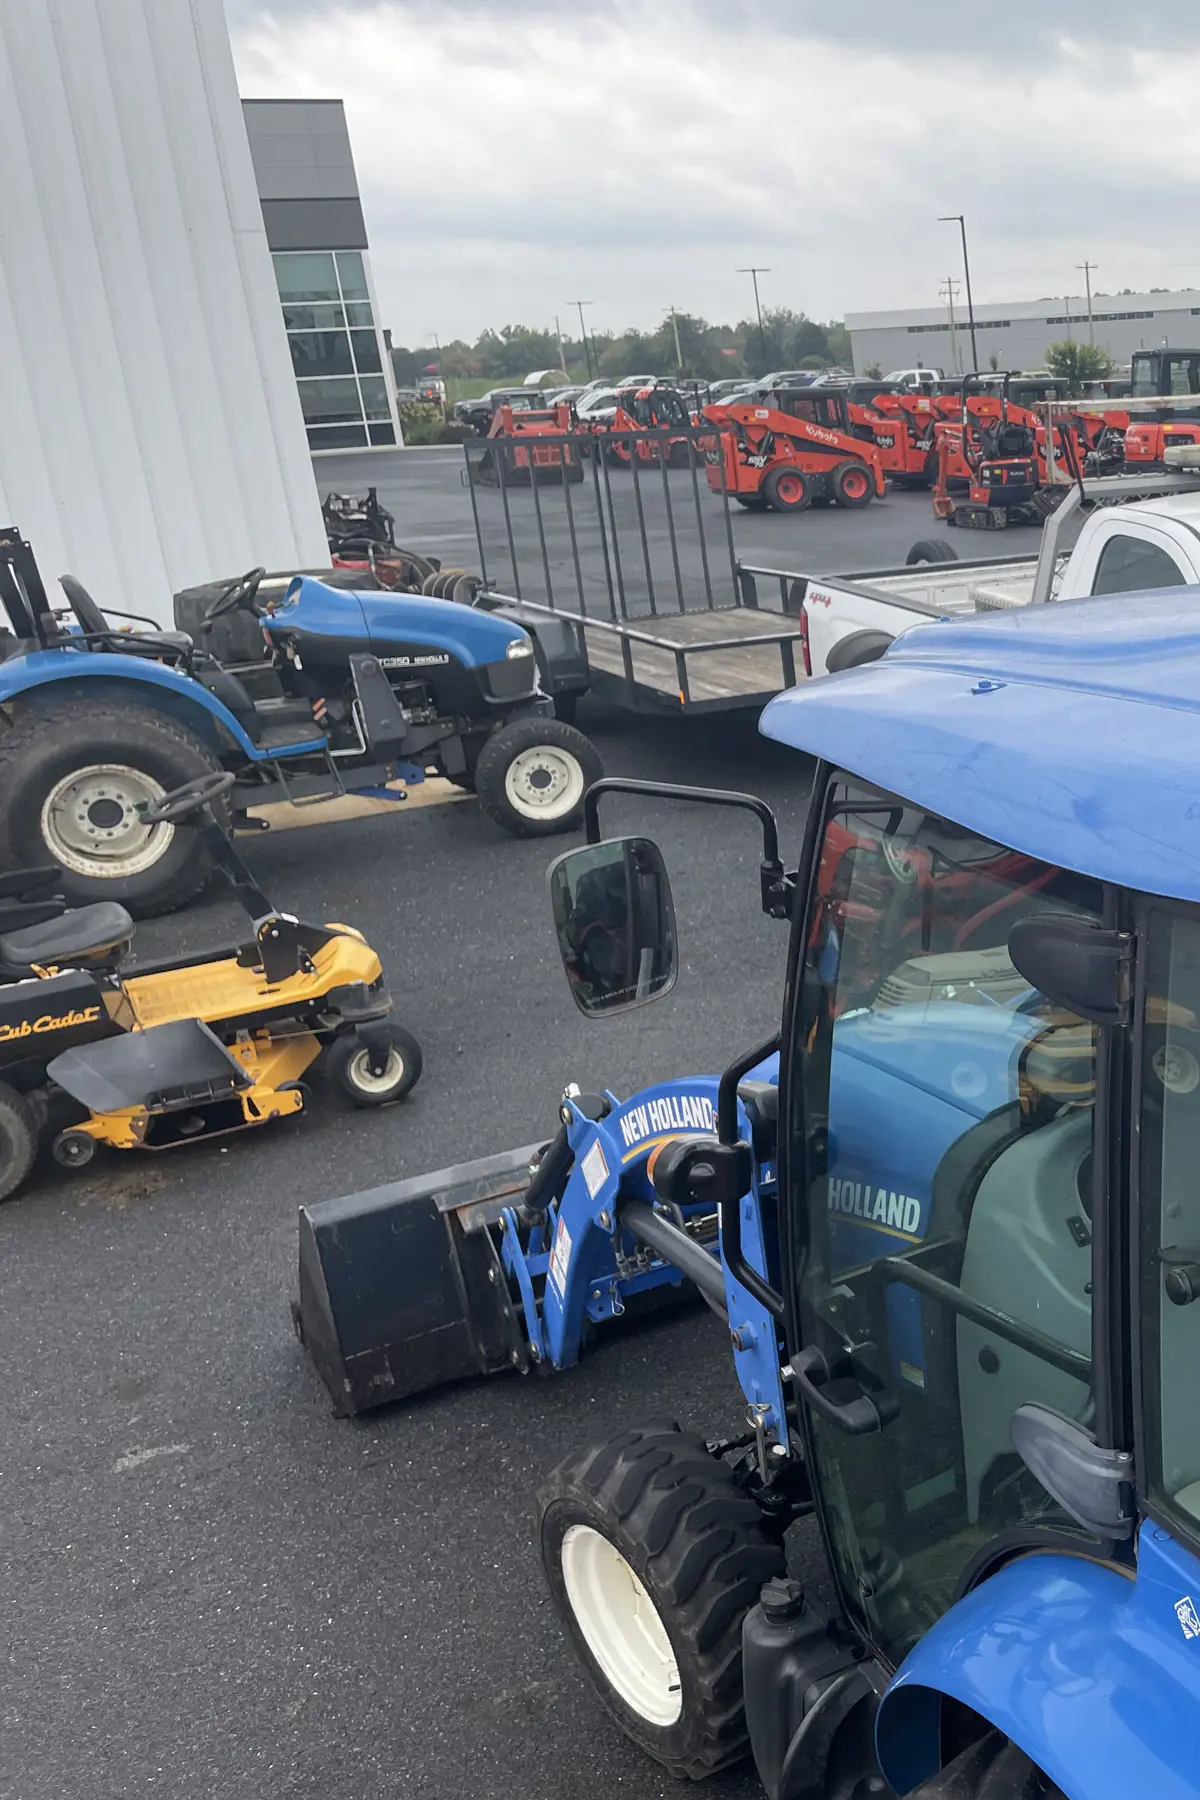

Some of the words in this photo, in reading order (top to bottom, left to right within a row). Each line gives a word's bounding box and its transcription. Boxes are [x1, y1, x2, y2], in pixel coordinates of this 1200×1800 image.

[805, 424, 838, 444] Kubota
[0, 1020, 32, 1042] Cub
[33, 1006, 100, 1033] Cadet
[620, 1104, 650, 1147] NEW
[647, 1096, 713, 1133] HOLLAND
[827, 1177, 921, 1233] HOLLAND
